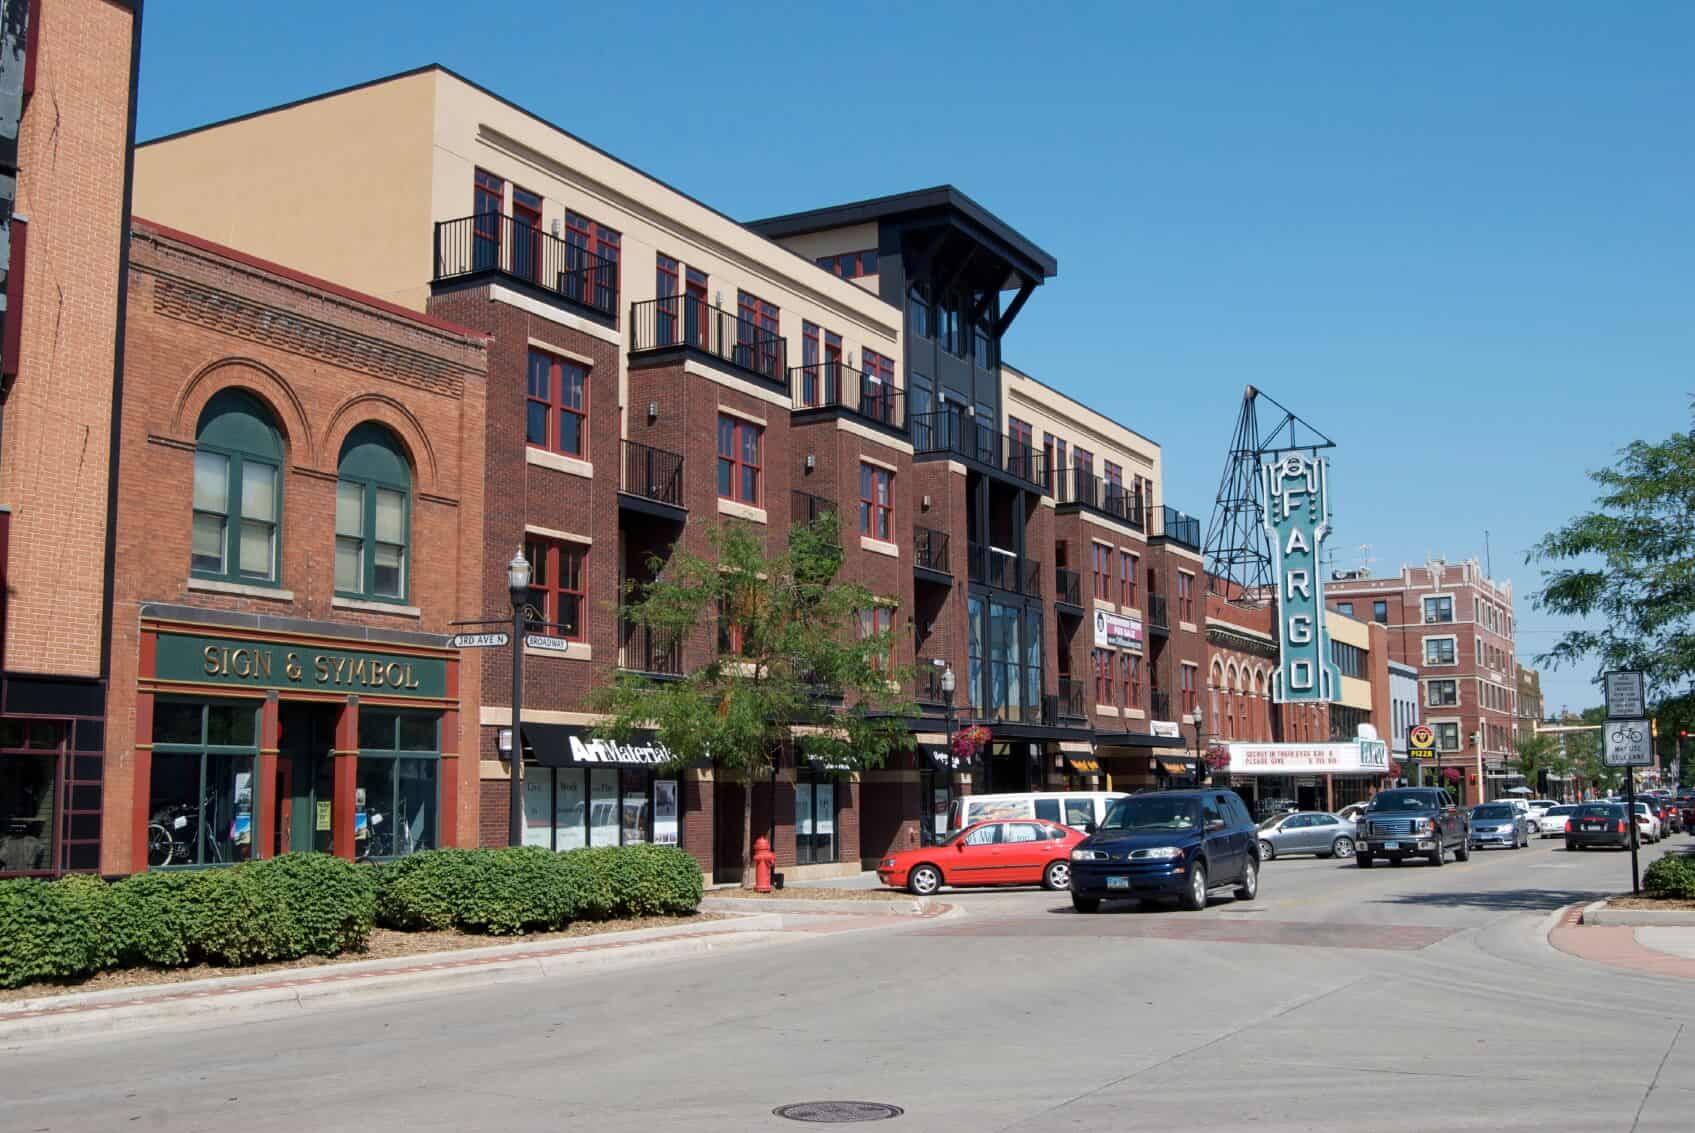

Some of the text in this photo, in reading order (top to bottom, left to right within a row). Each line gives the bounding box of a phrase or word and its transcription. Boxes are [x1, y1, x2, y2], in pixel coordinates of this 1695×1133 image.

[1283, 488, 1313, 690] FARGO
[458, 634, 504, 645] 3RD AVE N
[529, 636, 565, 649] BROADWAY
[203, 645, 420, 689] SIGN & SYMBOL
[1411, 750, 1433, 758] PIZZA
